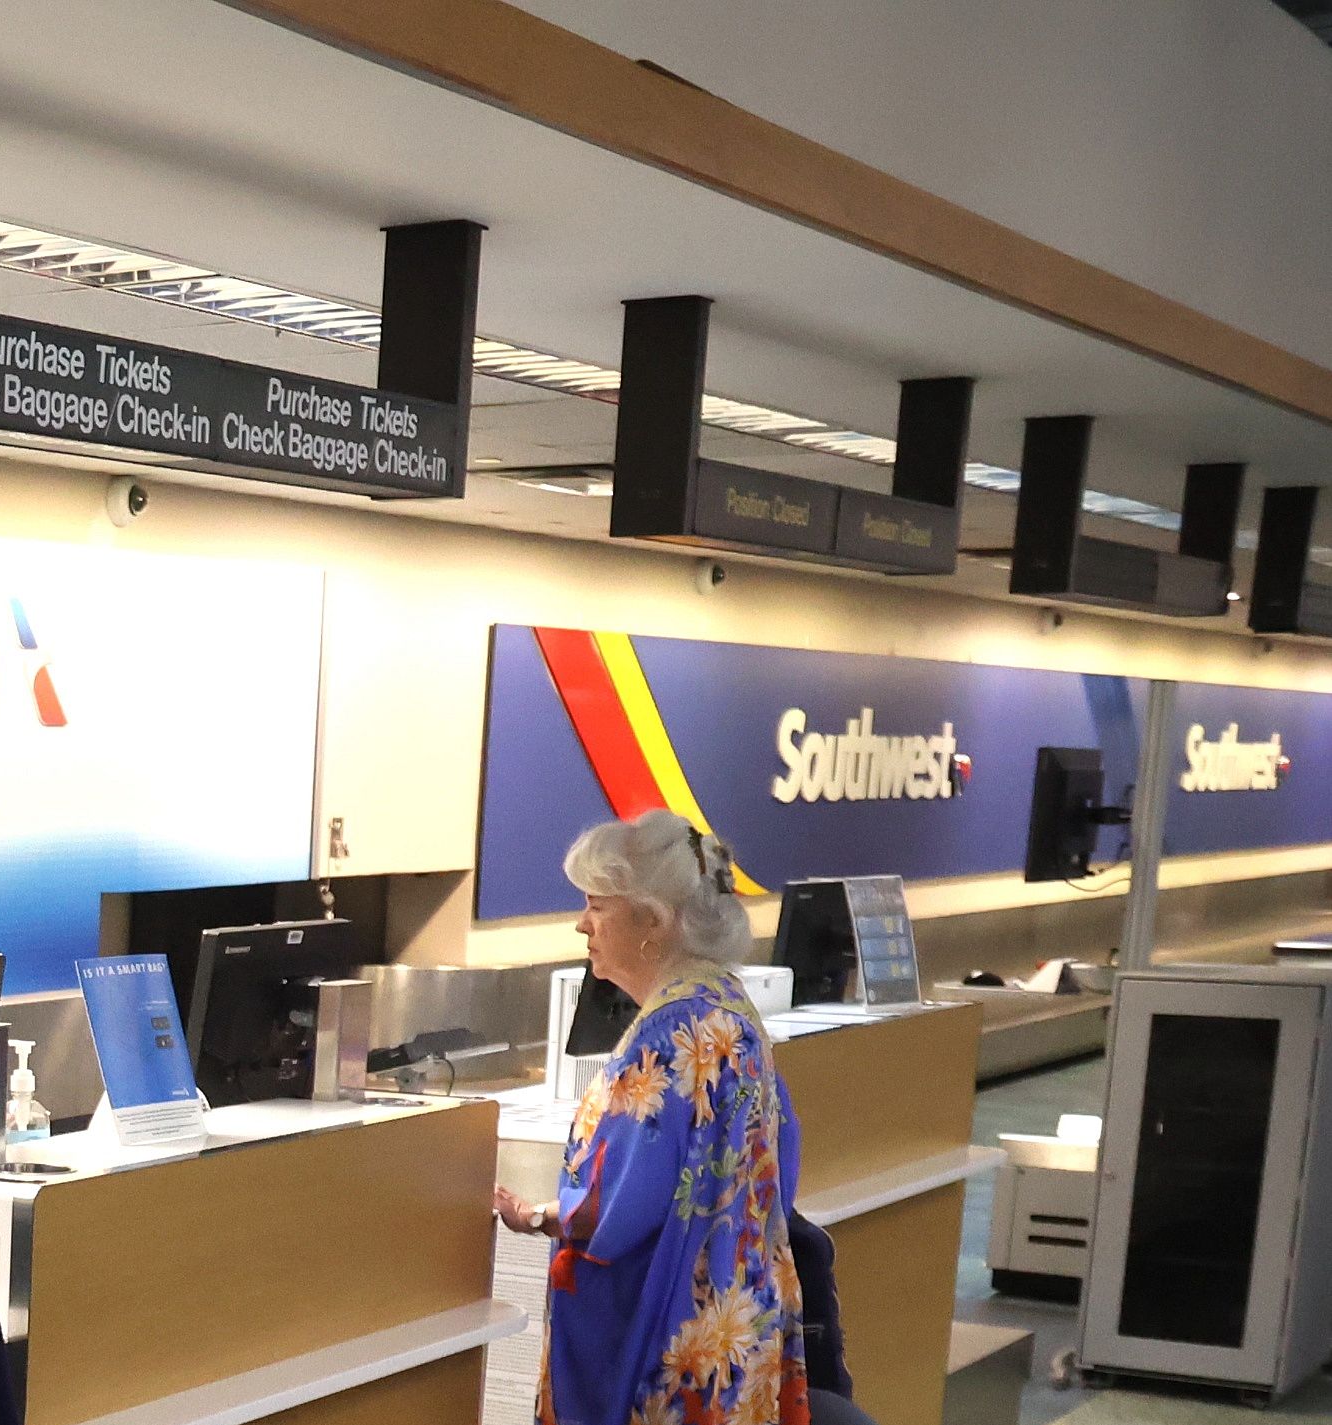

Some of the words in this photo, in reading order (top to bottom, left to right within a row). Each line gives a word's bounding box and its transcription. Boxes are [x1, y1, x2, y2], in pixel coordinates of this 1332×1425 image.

[96, 344, 172, 396] Tickets
[3, 373, 211, 444] Baggage/Check-in
[222, 412, 285, 457] Check
[266, 377, 352, 428] Purchase
[360, 395, 419, 439] Tickets
[771, 706, 957, 804] Southwest
[1180, 721, 1283, 793] Southwest
[116, 963, 146, 975] SMART
